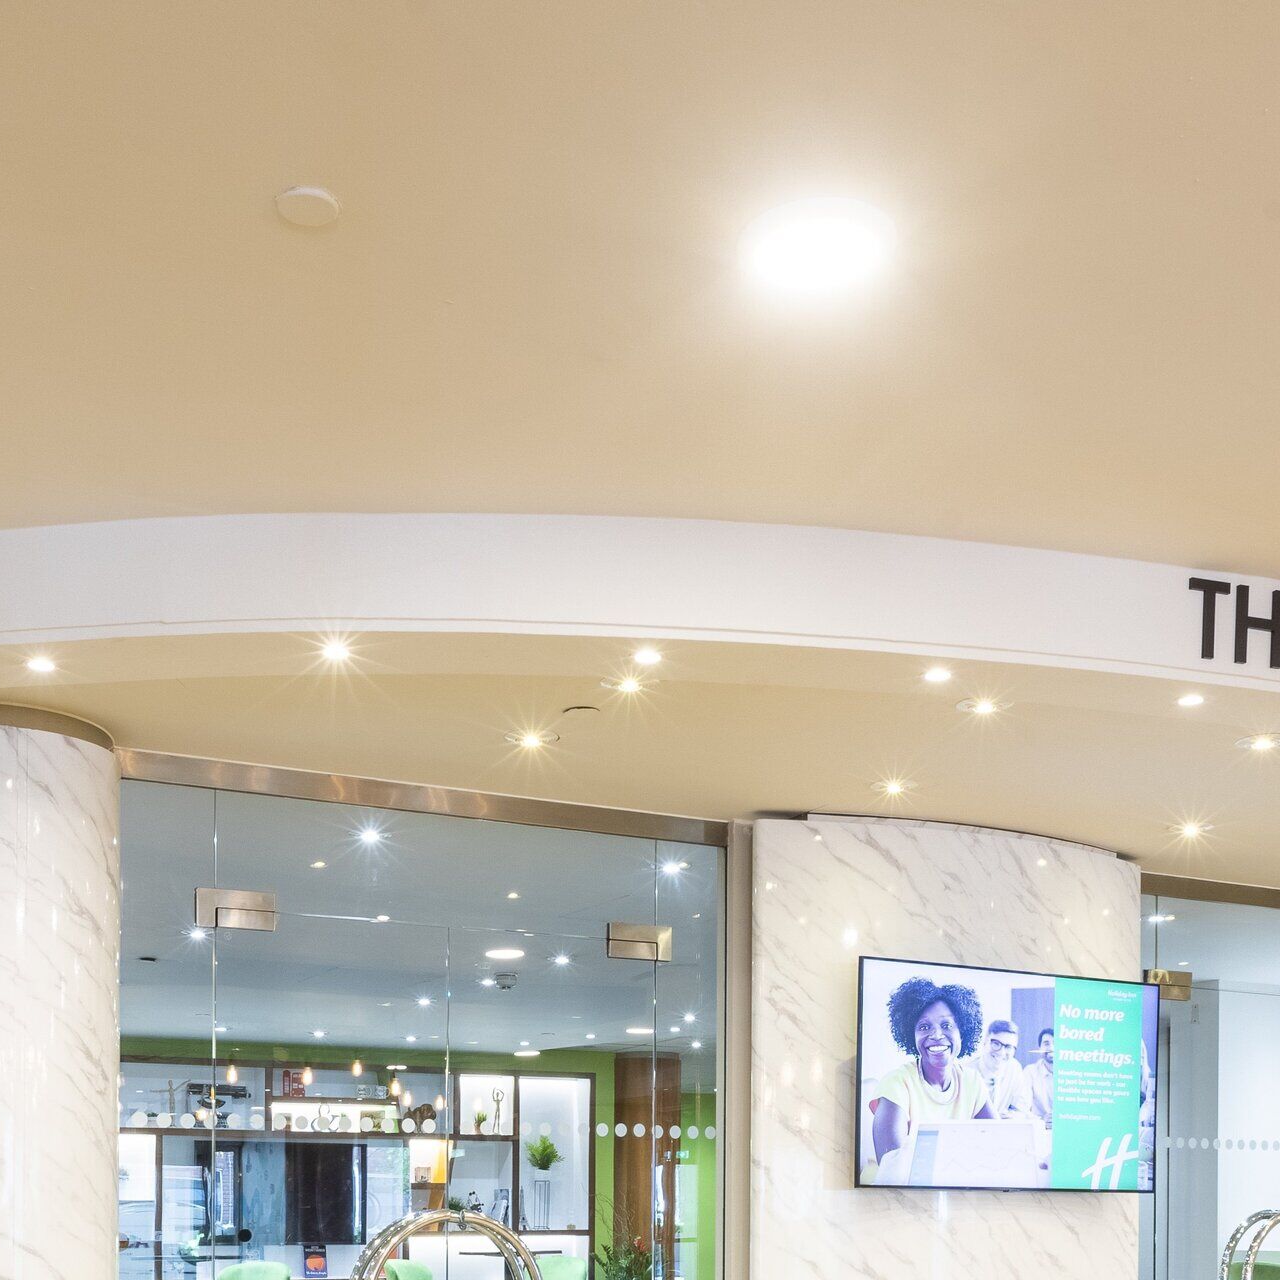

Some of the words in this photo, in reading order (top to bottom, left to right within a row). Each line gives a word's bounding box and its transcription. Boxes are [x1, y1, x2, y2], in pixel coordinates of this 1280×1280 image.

[1059, 1004, 1081, 1019] No
[1084, 1008, 1125, 1022] more
[1059, 1024, 1105, 1042] bored
[1058, 1048, 1135, 1068] meetings.
